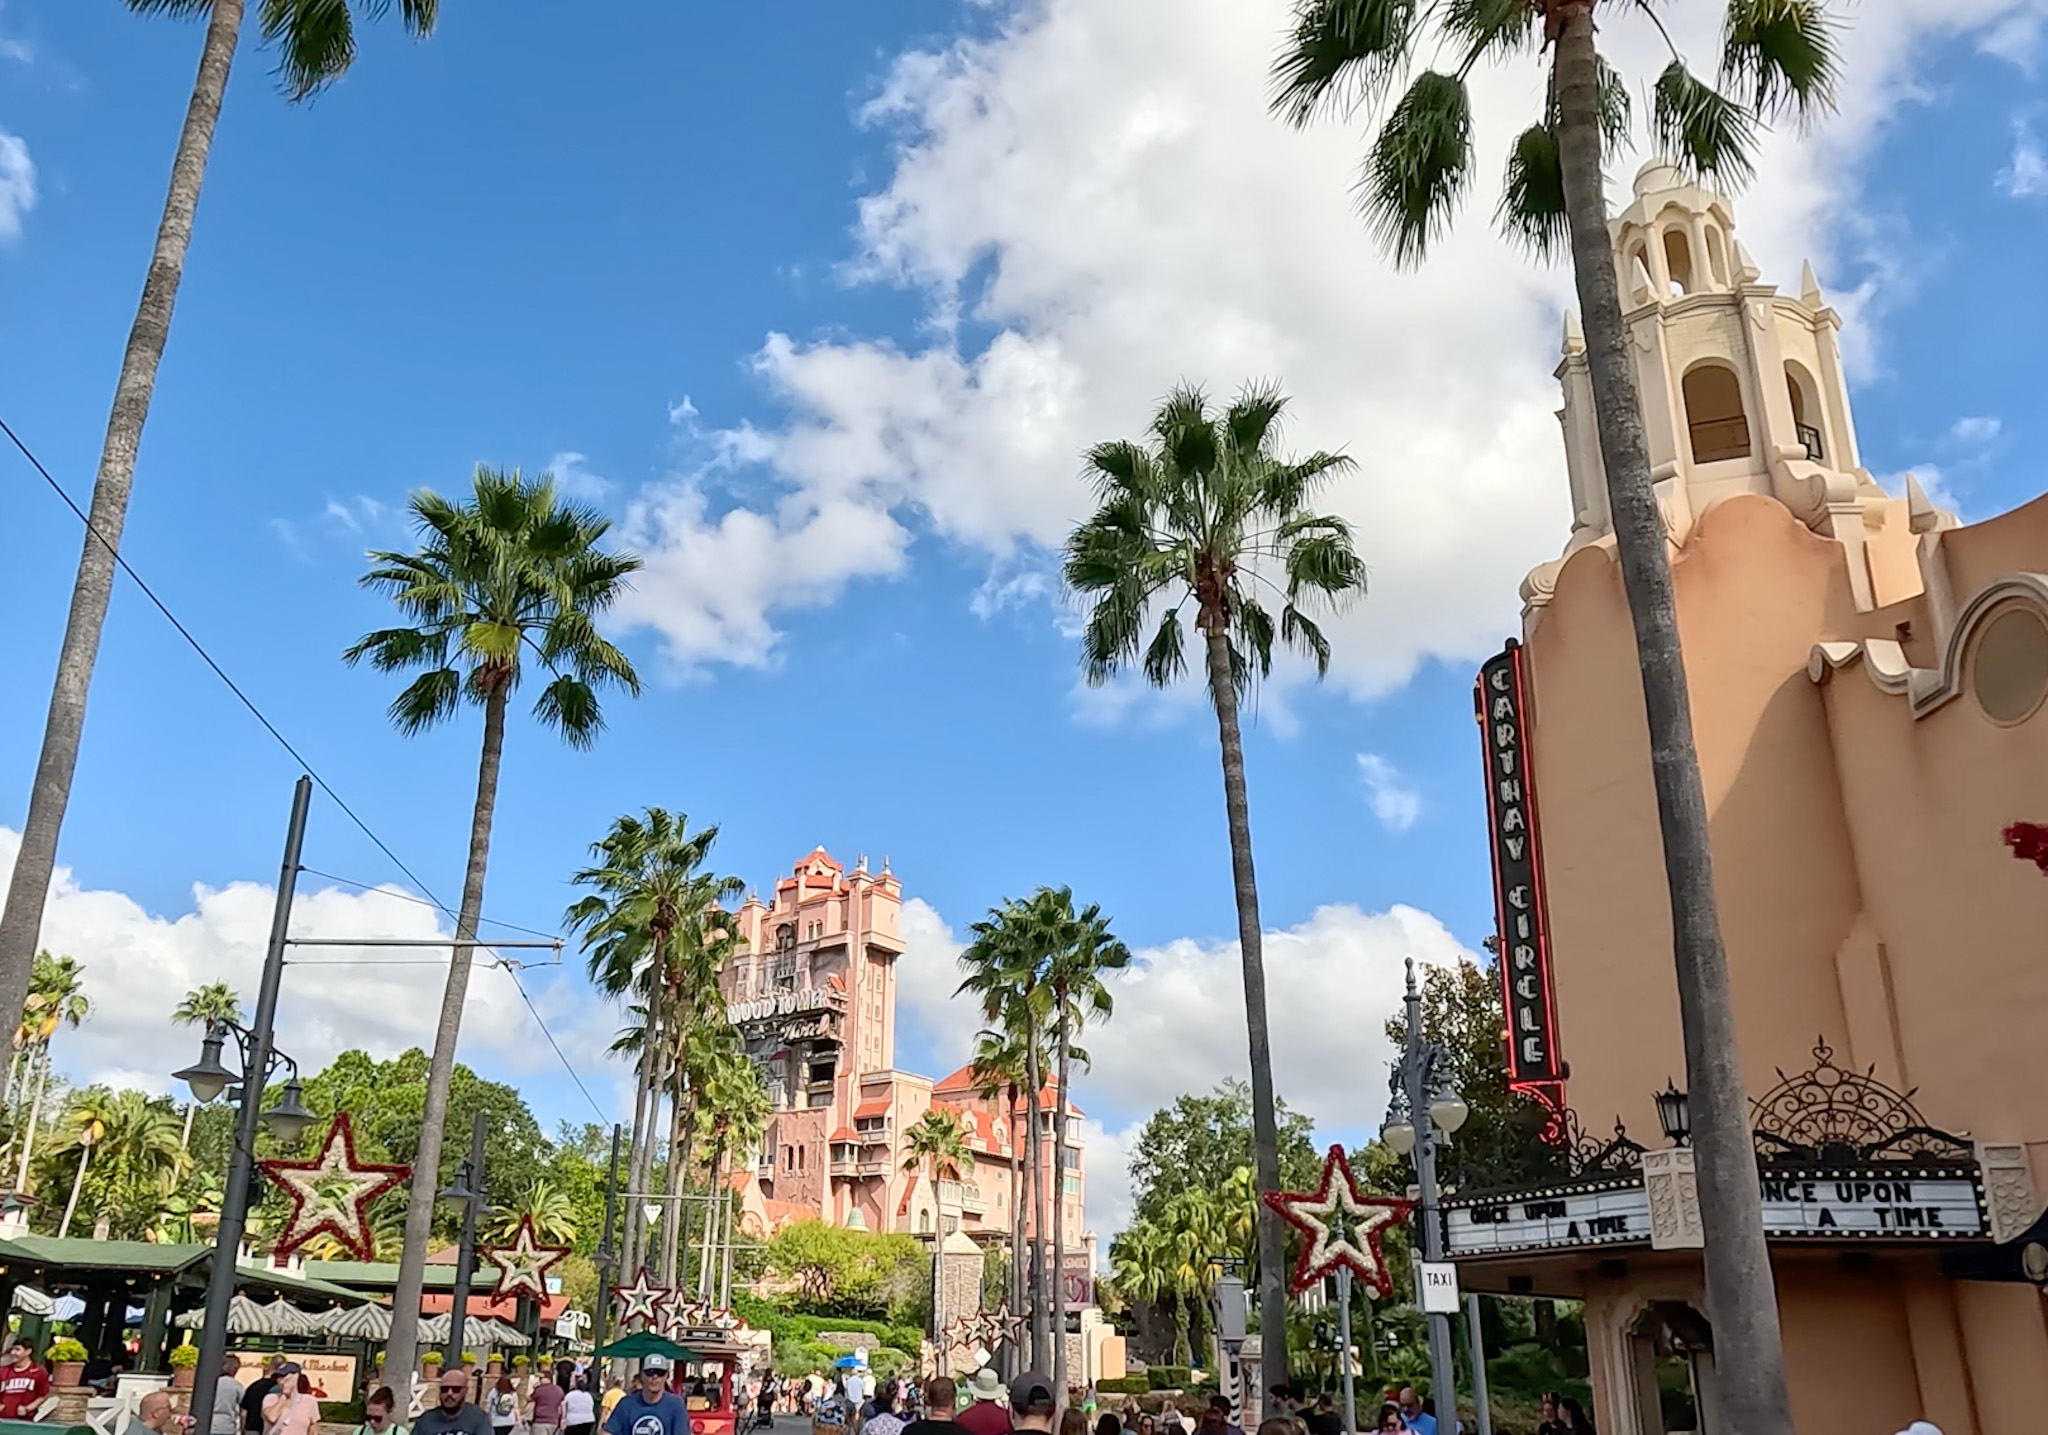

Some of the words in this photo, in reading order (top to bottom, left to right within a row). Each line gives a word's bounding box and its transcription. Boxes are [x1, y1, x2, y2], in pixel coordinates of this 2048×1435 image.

[1491, 667, 1525, 862] CARTHAY
[1508, 885, 1544, 1065] CIRCLE
[778, 988, 829, 1015] TOWER
[1835, 1182, 1913, 1203] UPON
[1470, 1206, 1510, 1225] ONCE
[1524, 1200, 1567, 1220] UPON
[1818, 1207, 1837, 1227] A
[1873, 1207, 1944, 1227] TIME
[1567, 1220, 1580, 1238] A
[1585, 1215, 1629, 1236] TIME
[1426, 1272, 1452, 1287] TAXI
